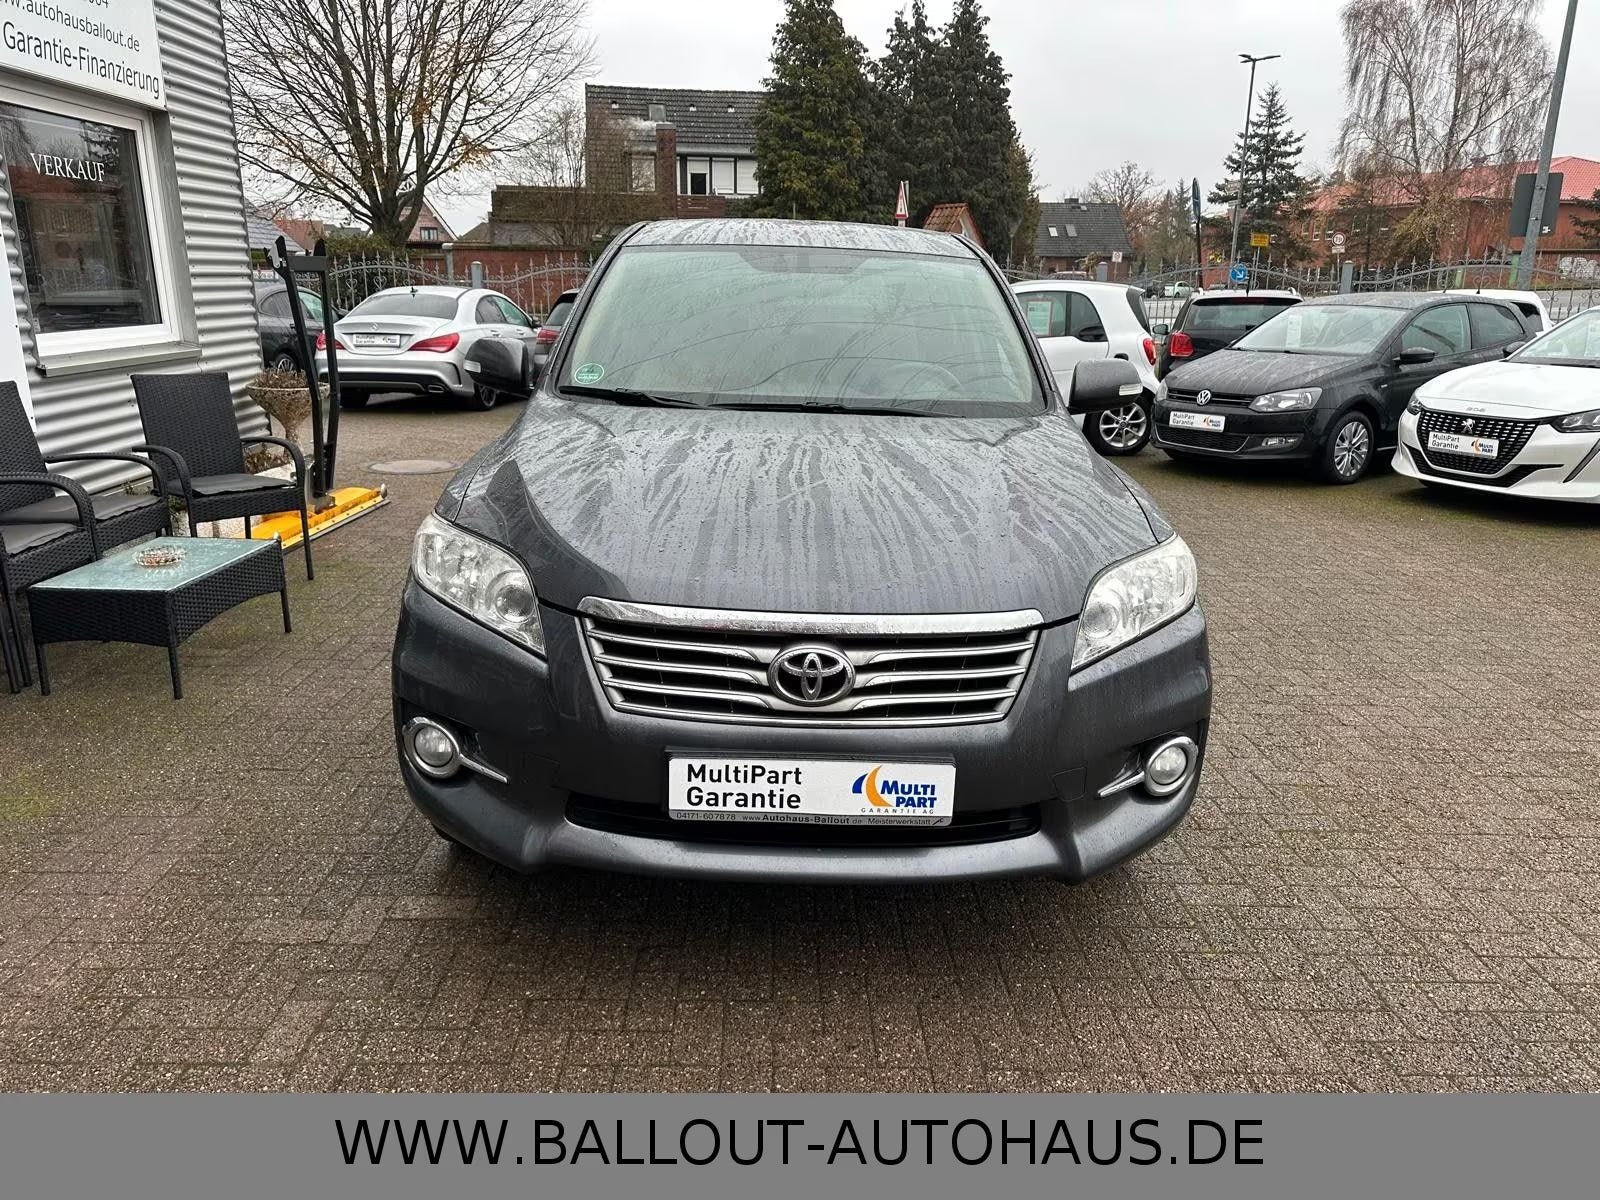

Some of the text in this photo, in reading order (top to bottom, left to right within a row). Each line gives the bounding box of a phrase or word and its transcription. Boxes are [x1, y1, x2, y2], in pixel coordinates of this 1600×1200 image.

[3, 21, 160, 99] Garantie-Finanzierung
[30, 153, 105, 182] VERKAUF
[1431, 440, 1459, 449] Garantie
[686, 764, 802, 786] MultiPart
[686, 786, 801, 809] Garantie
[880, 780, 936, 796] MULTI
[895, 796, 938, 808] PART
[676, 811, 931, 826] 04171-607878 www.Autohaus-Balloutde Meisterwerkstatt
